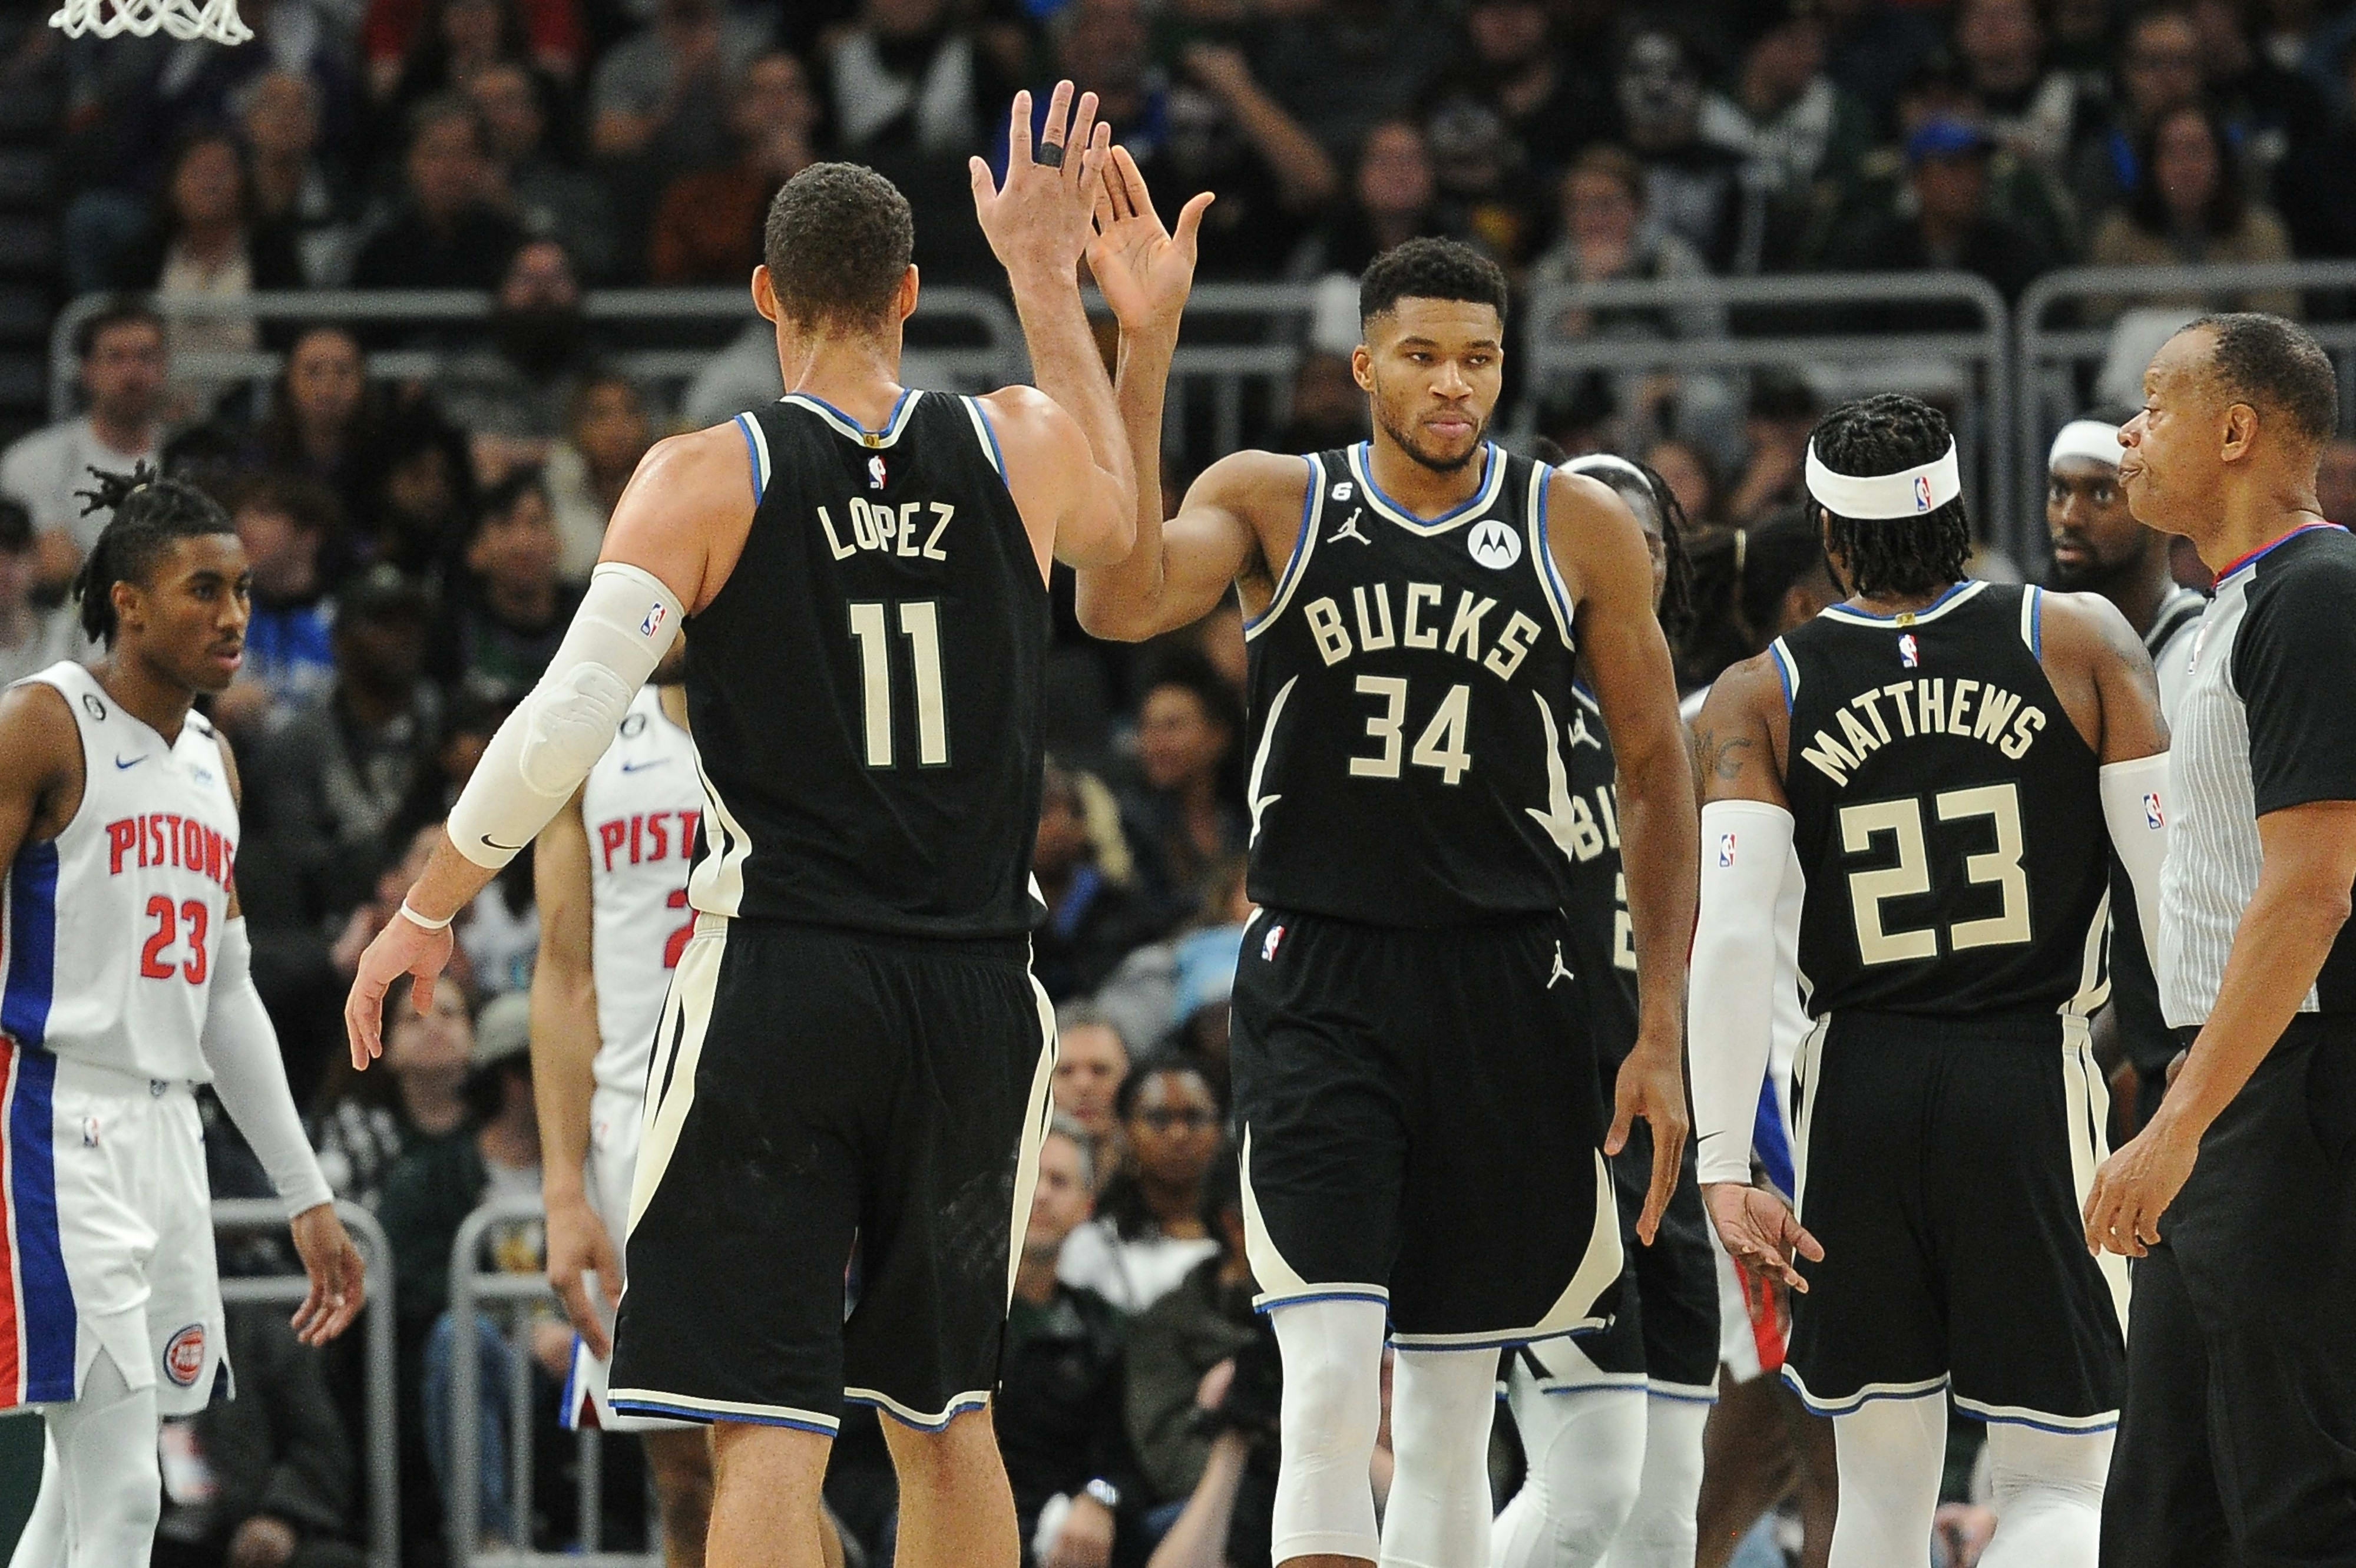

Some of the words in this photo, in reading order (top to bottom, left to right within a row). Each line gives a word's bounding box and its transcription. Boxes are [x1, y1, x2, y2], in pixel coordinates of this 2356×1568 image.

[817, 497, 955, 561] LOPEZ
[1331, 481, 1353, 501] 6
[1303, 581, 1542, 682] BUCKS
[849, 600, 948, 767] 11
[1349, 674, 1471, 785] 34
[1801, 677, 2047, 788] MATTHEWS
[105, 813, 234, 893] PISTONS
[599, 810, 700, 872] PIST
[1839, 782, 2031, 965] 23
[141, 894, 208, 985] 23
